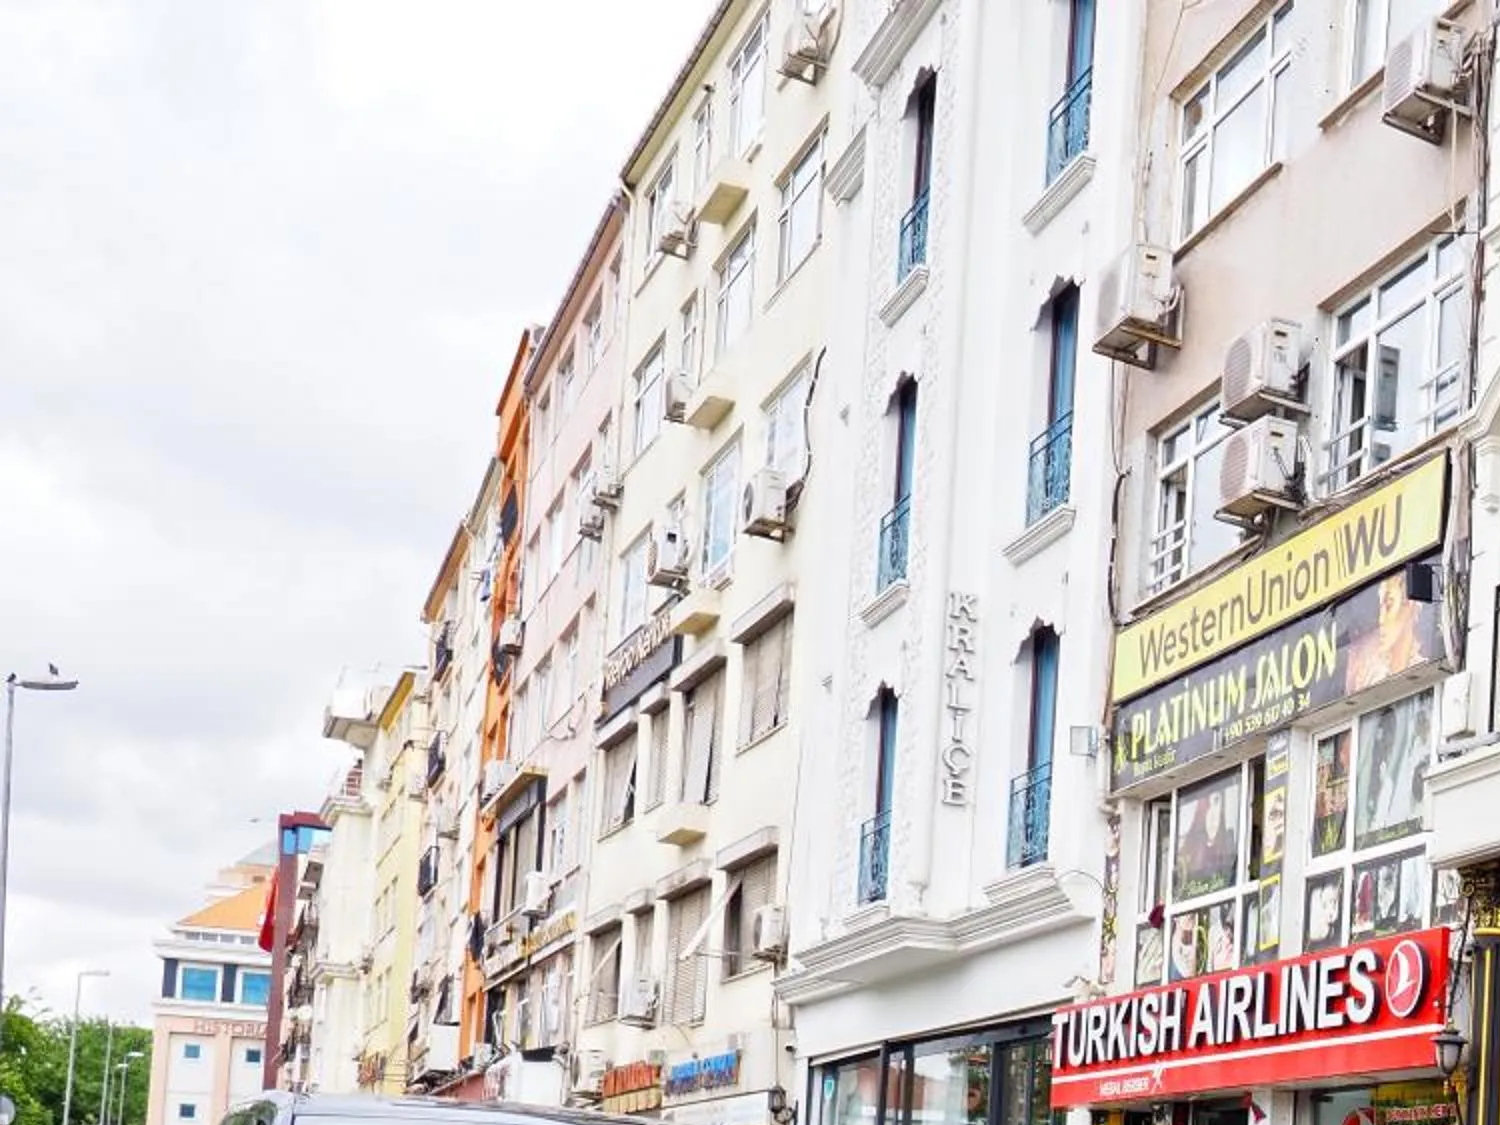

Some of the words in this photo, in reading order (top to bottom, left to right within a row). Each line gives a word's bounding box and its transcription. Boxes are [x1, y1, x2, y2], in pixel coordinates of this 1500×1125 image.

[1139, 546, 1330, 679] WesternUnion
[1242, 622, 1338, 710] SALON
[1051, 988, 1185, 1070] TURKISH
[1190, 947, 1378, 1046] AIRLINES
